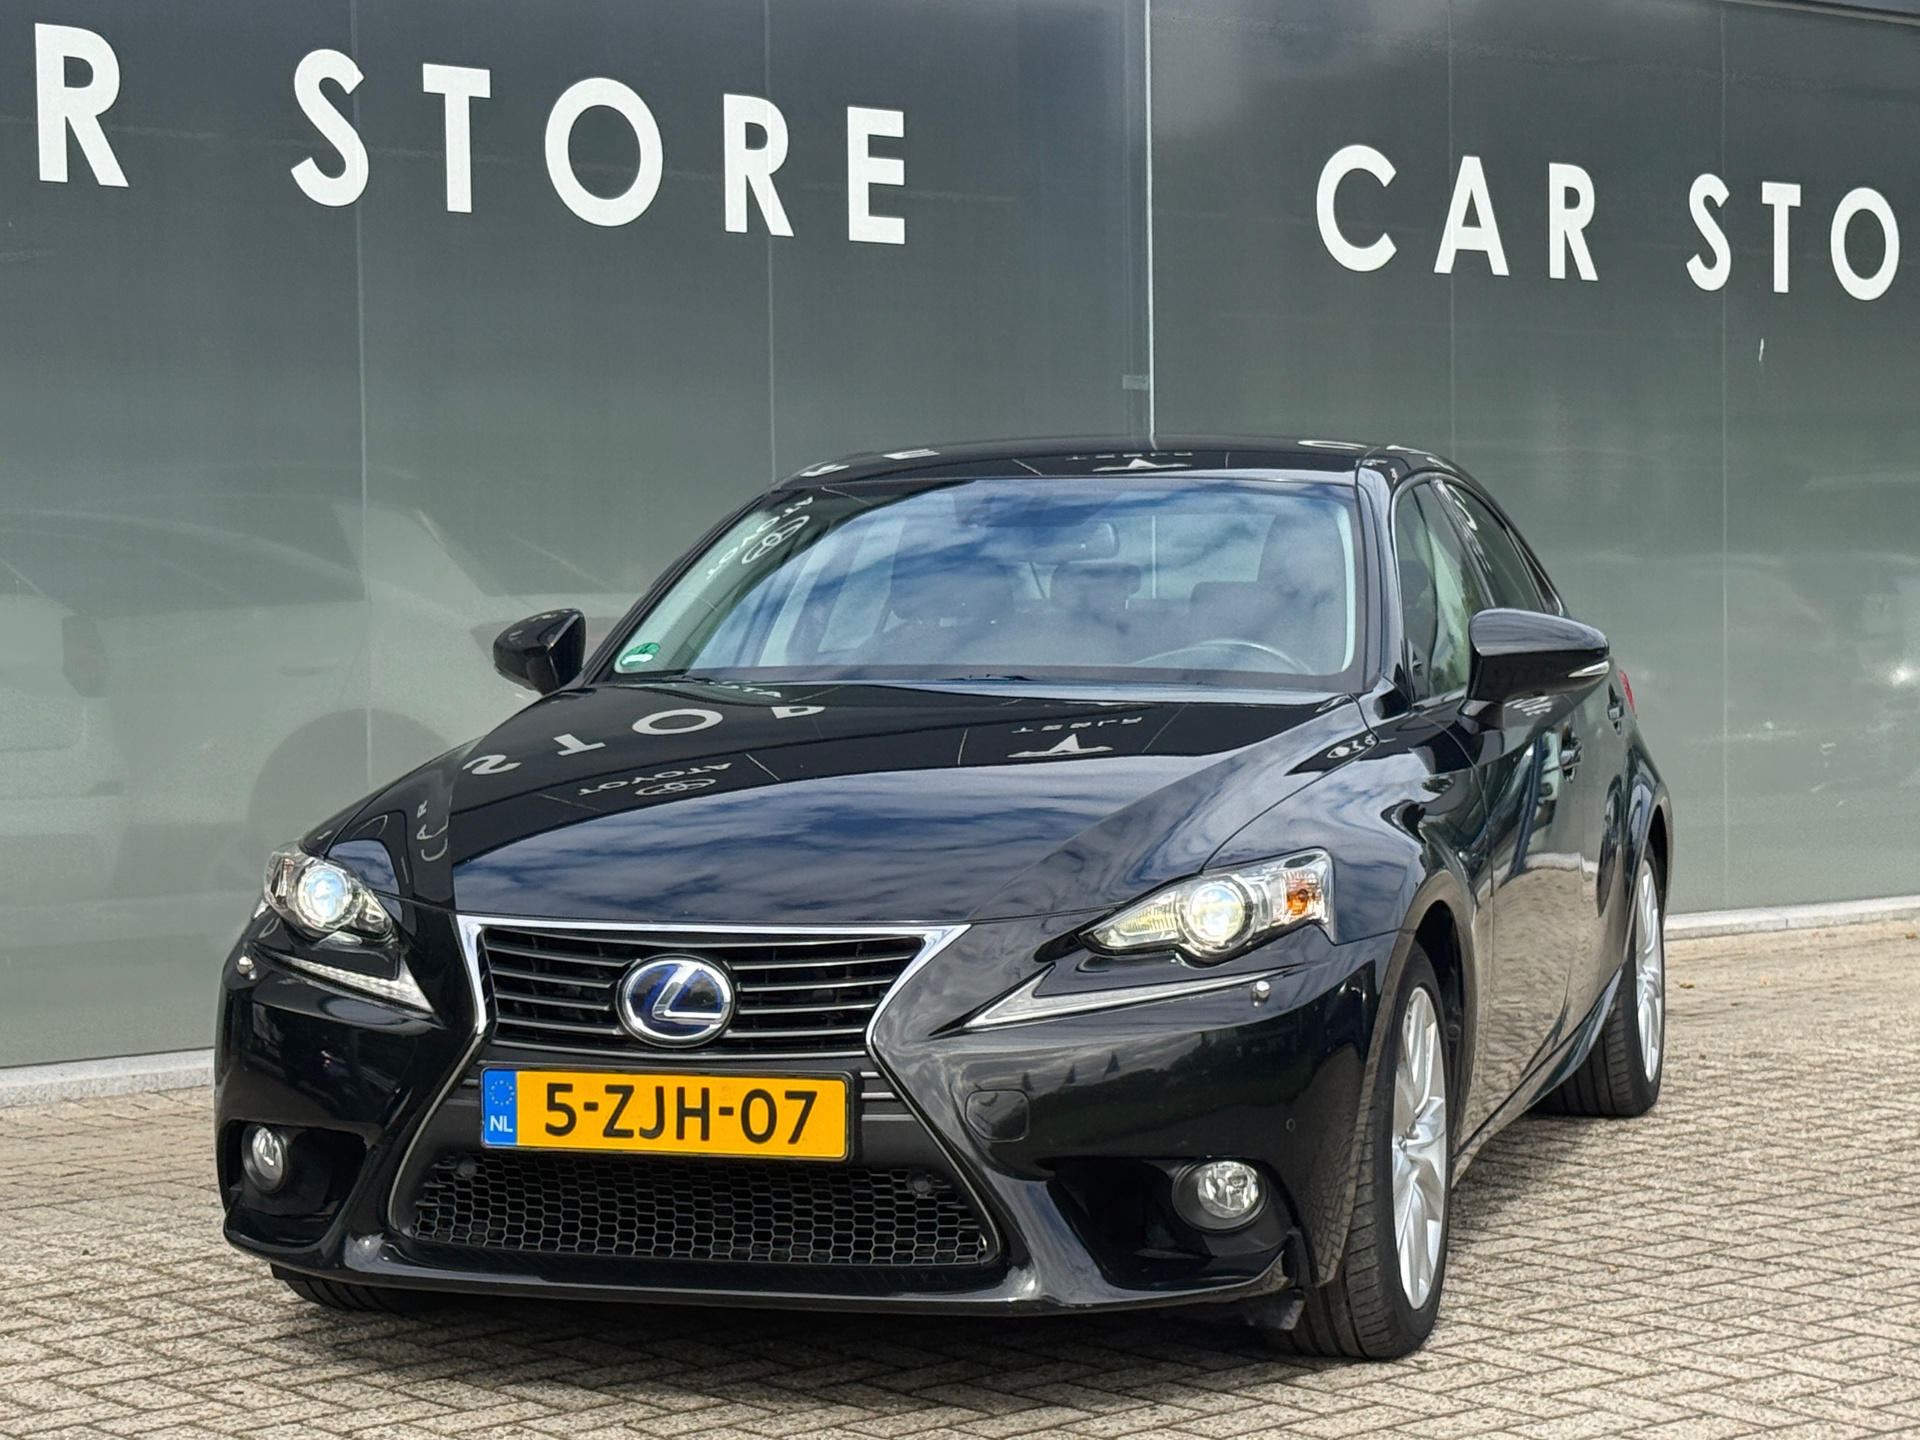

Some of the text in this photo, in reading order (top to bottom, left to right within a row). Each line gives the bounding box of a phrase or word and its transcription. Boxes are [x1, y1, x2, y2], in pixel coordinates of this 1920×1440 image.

[291, 49, 905, 245] STORE
[1317, 145, 1900, 301] CAR STO
[490, 1115, 513, 1133] NL
[545, 1082, 818, 1144] 5-ZJH-07
